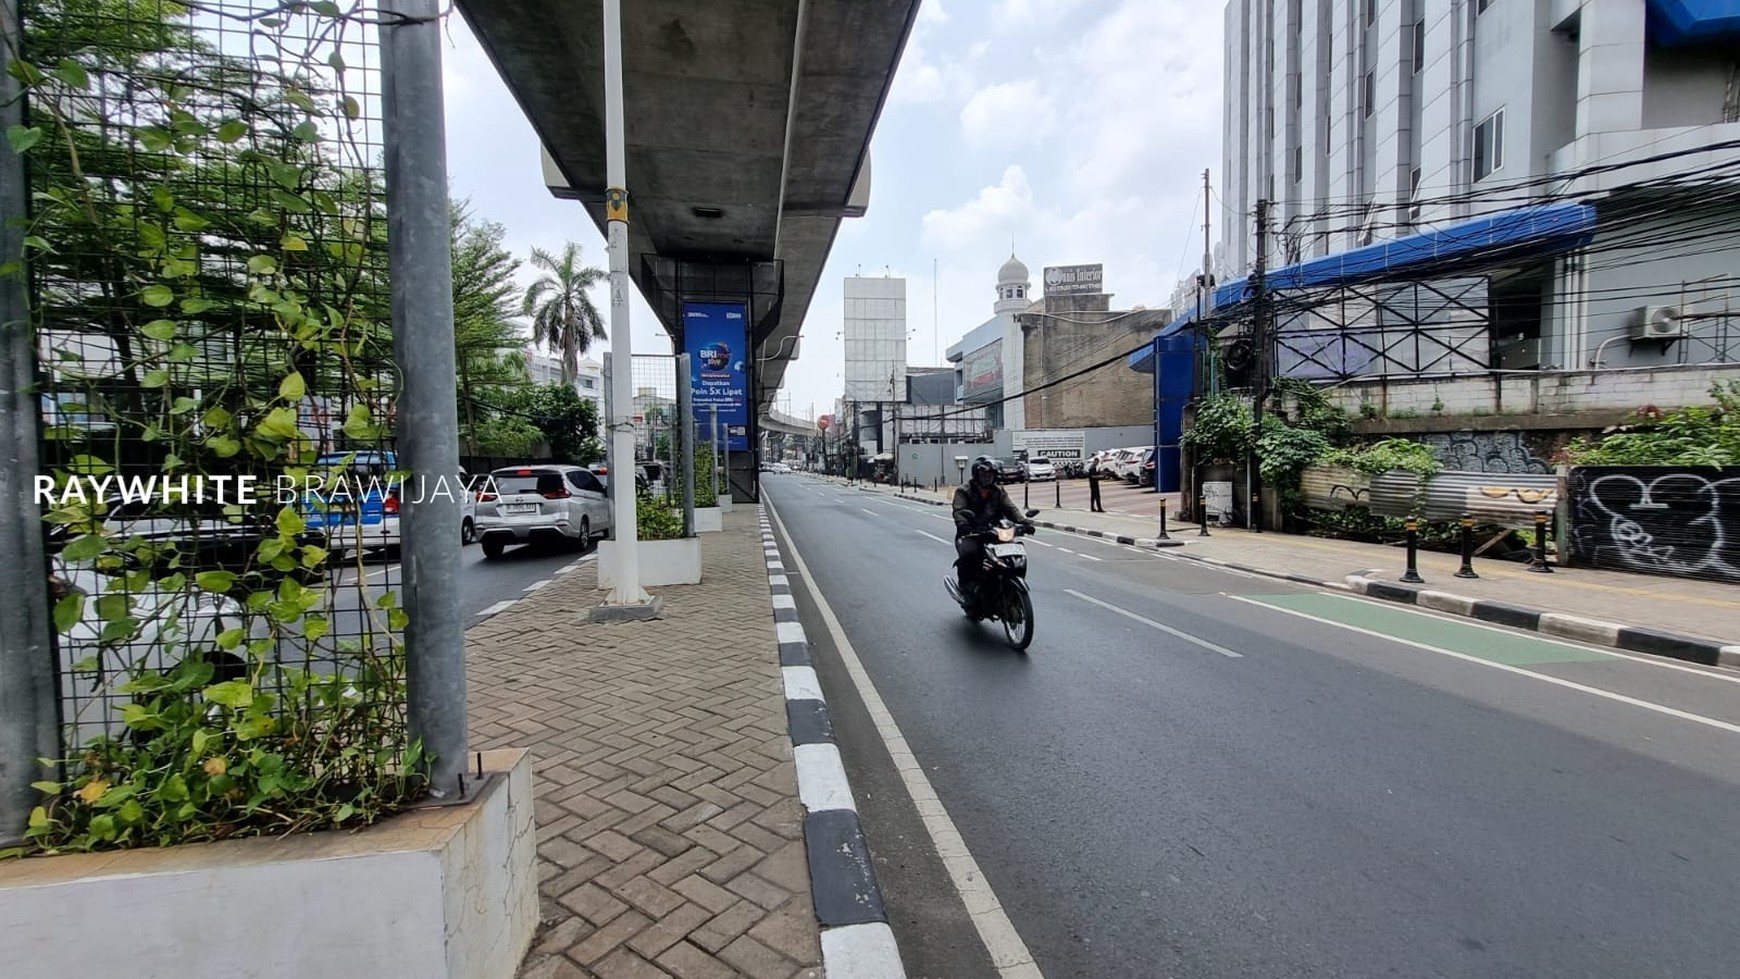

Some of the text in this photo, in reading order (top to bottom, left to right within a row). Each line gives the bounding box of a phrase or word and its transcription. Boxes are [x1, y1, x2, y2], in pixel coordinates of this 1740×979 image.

[691, 387, 708, 395] Poin
[722, 387, 743, 396] Lipat
[1040, 450, 1078, 458] CAUTION
